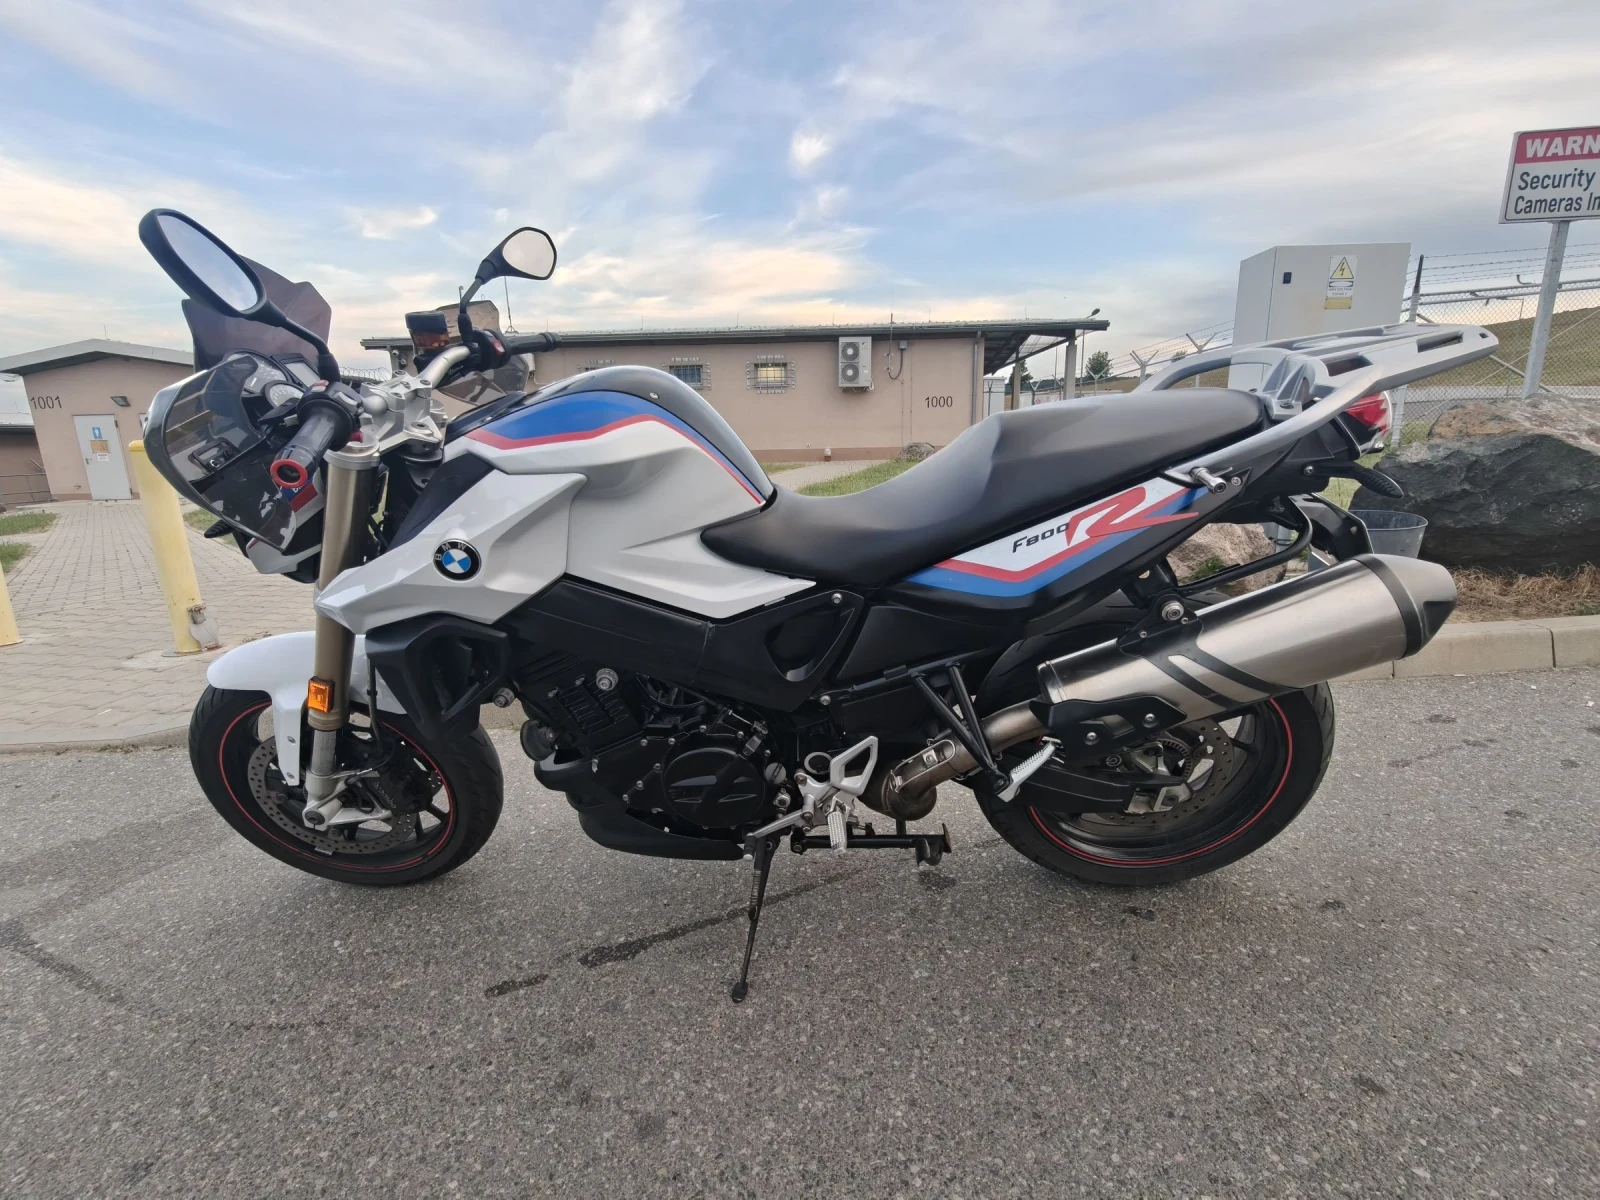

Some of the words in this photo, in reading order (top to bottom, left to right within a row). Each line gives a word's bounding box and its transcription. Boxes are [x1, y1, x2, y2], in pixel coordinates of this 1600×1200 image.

[1526, 134, 1600, 158] WARN
[1518, 167, 1596, 192] Security
[1514, 195, 1583, 215] Cameras
[30, 395, 62, 410] 1001
[924, 395, 953, 409] 1000
[434, 542, 467, 561] BMW
